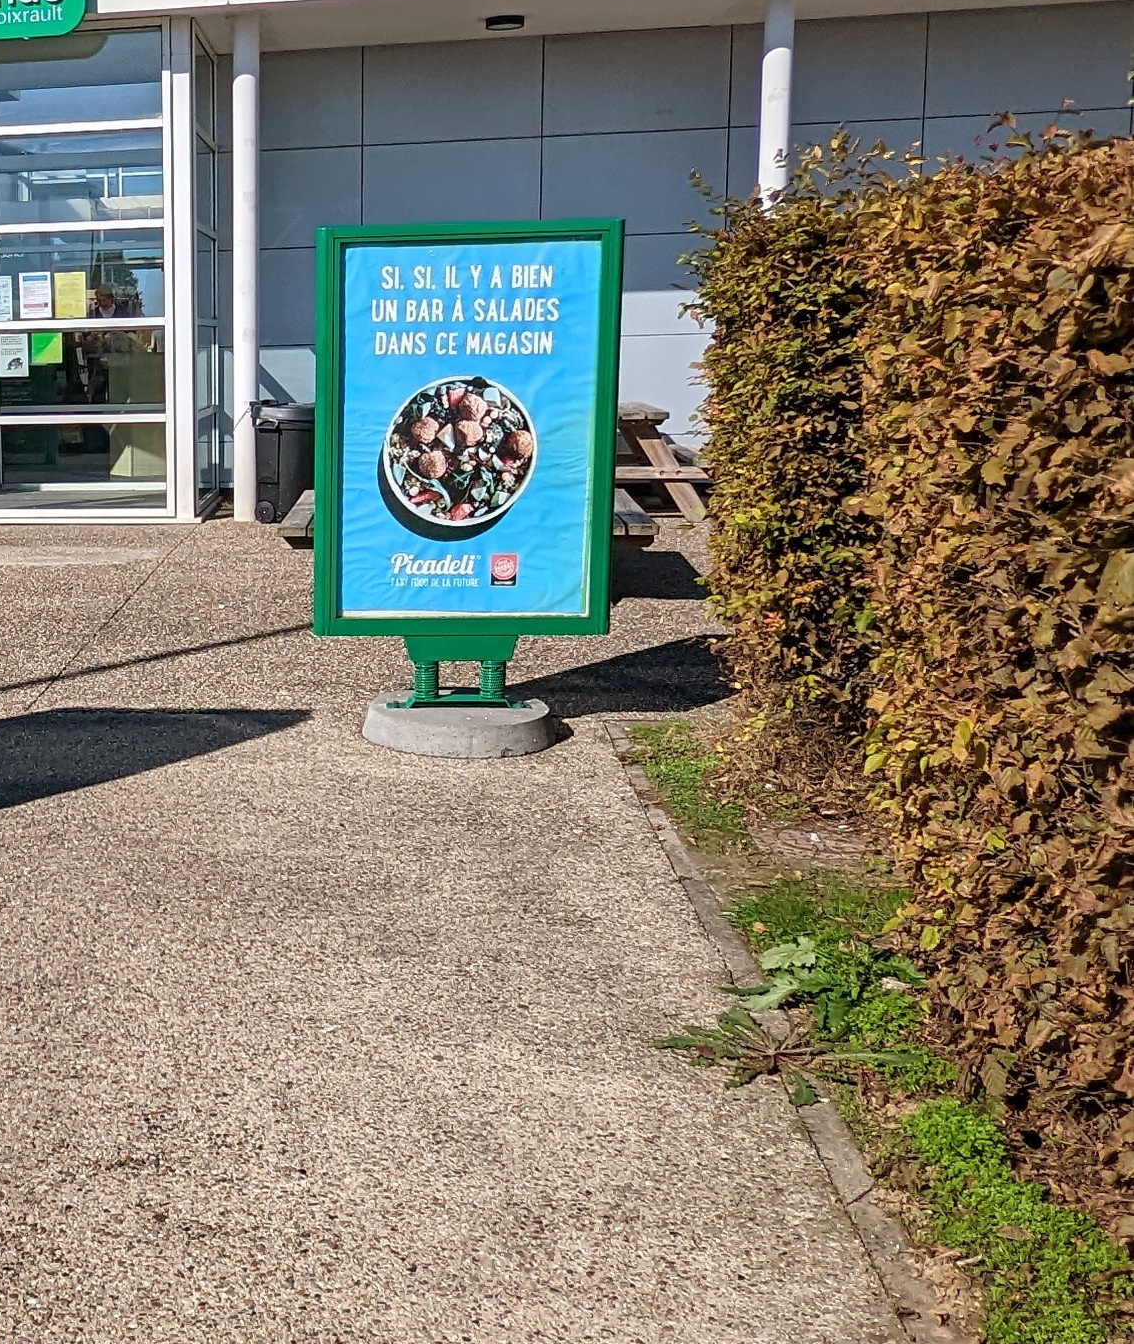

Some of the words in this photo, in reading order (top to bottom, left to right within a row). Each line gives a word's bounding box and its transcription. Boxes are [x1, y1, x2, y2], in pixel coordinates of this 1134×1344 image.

[445, 265, 460, 288] IL
[470, 265, 482, 288] Y
[490, 265, 502, 288] A
[511, 265, 553, 288] BIEN
[371, 299, 398, 323] UN
[405, 299, 444, 323] BAR
[451, 294, 465, 323] À
[473, 298, 560, 323] SALADES
[374, 331, 428, 355] DANS
[435, 331, 459, 355] CE
[466, 331, 554, 355] MAGASIN
[390, 553, 476, 575] Picadeli
[453, 577, 480, 587] FUTURE
